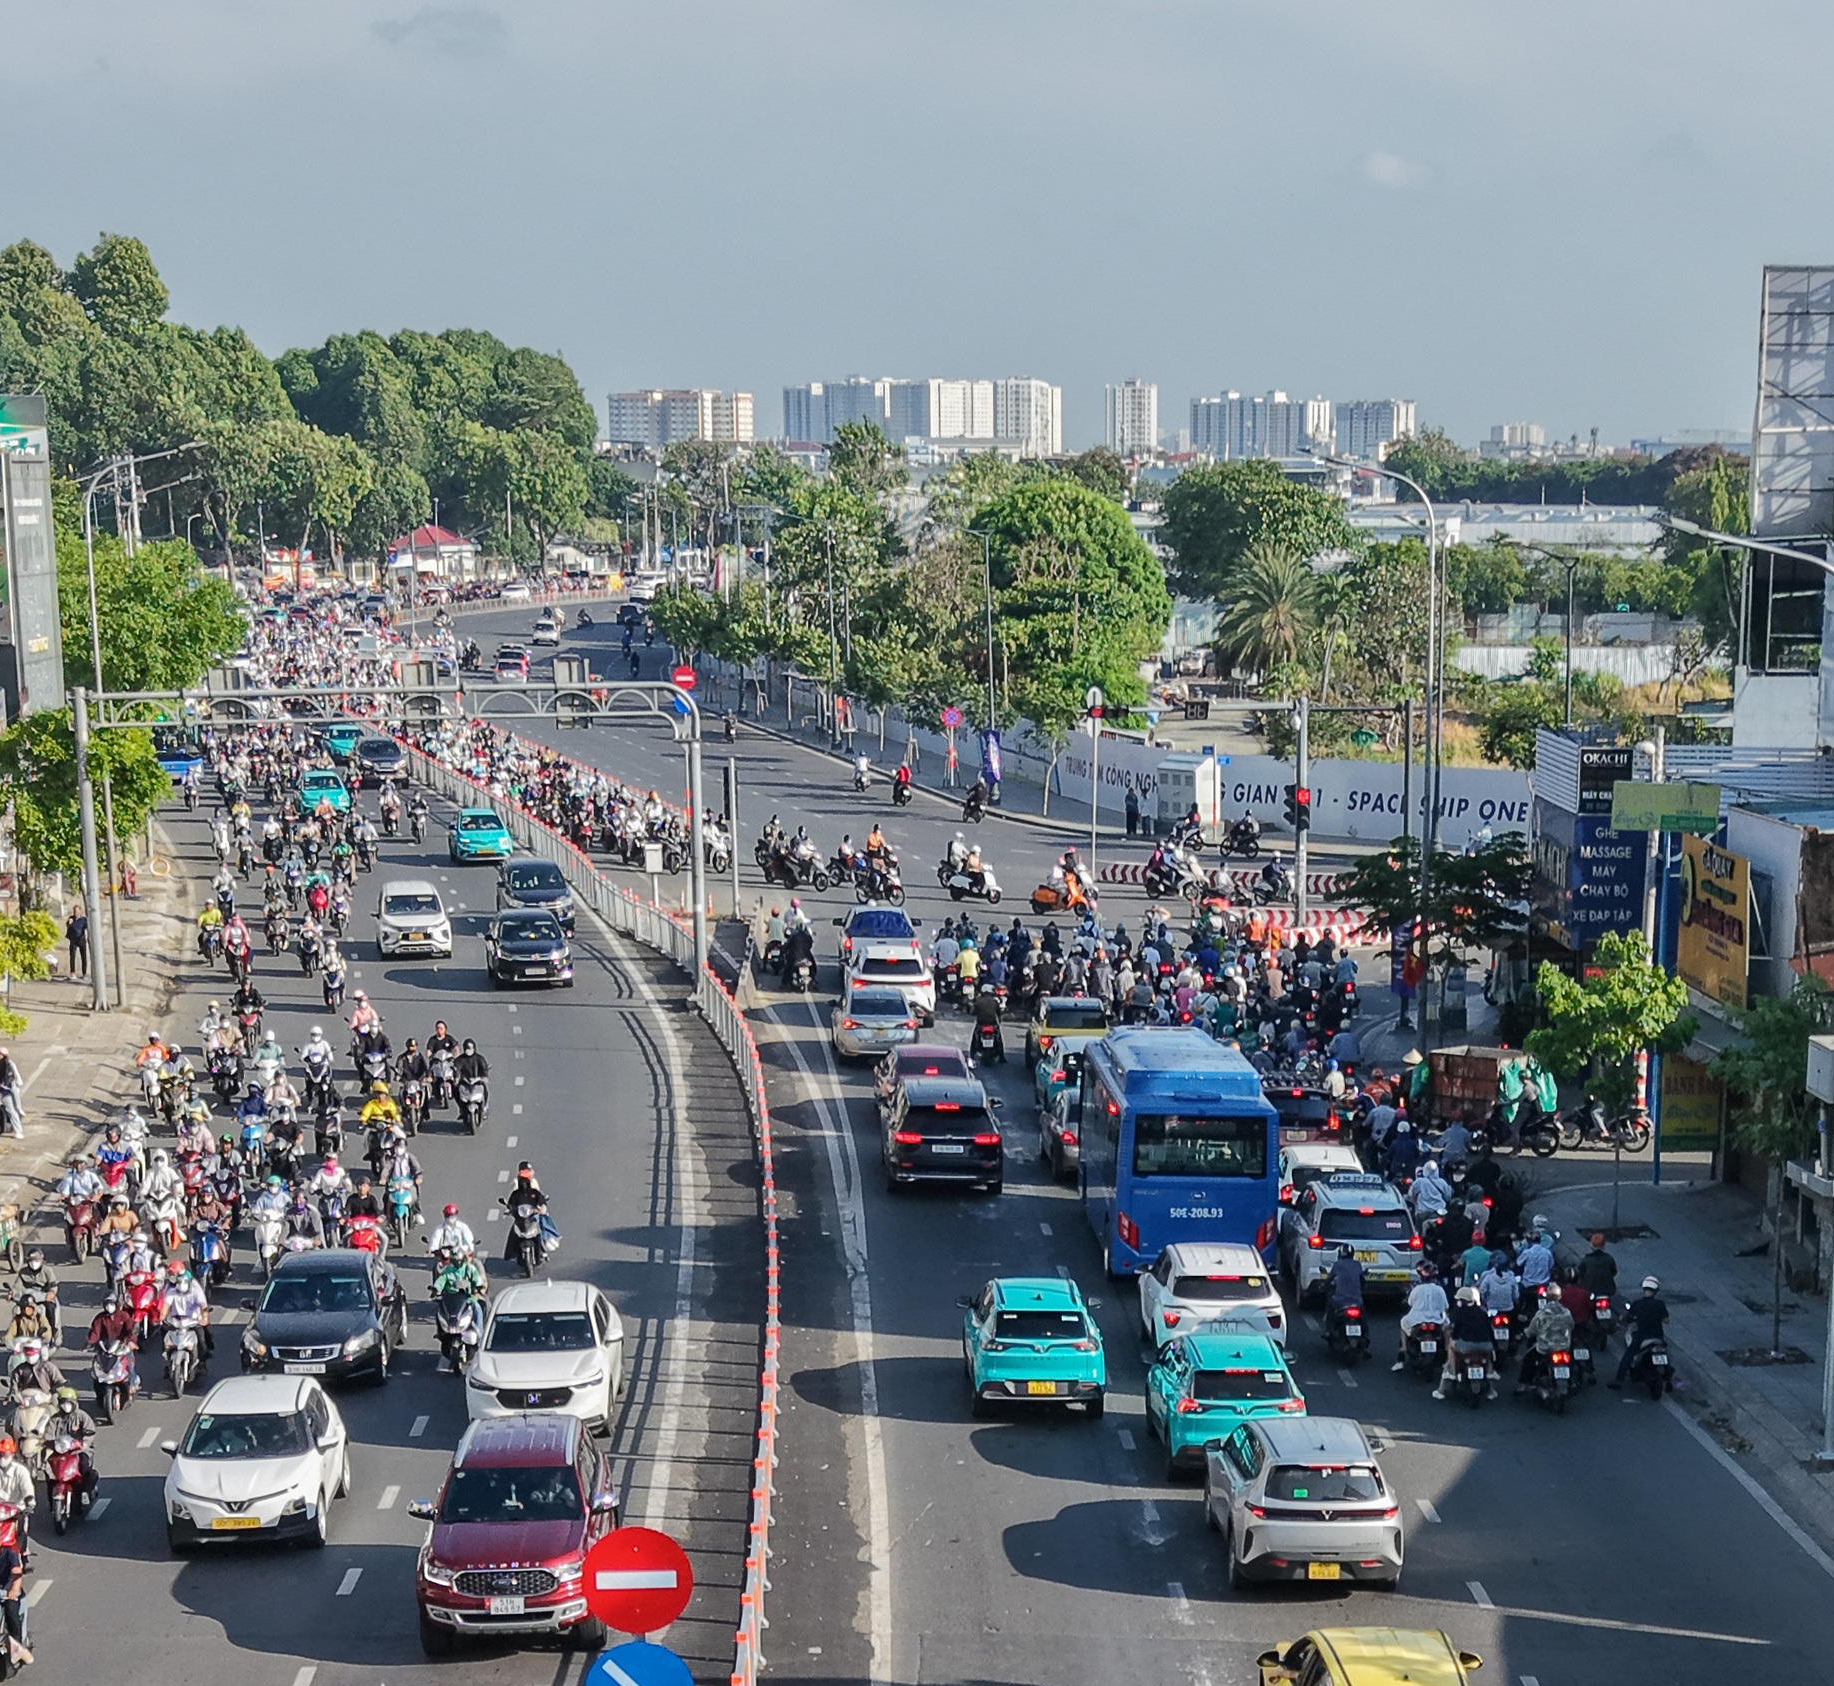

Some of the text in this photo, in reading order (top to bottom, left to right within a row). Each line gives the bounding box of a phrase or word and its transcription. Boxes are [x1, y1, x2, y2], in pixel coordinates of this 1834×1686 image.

[1583, 752, 1629, 765] OKACHI
[1105, 763, 1131, 788] CÔNG
[1233, 783, 1277, 804] GIAN
[1478, 799, 1529, 822] ONE
[1580, 846, 1633, 859] MASSAGE
